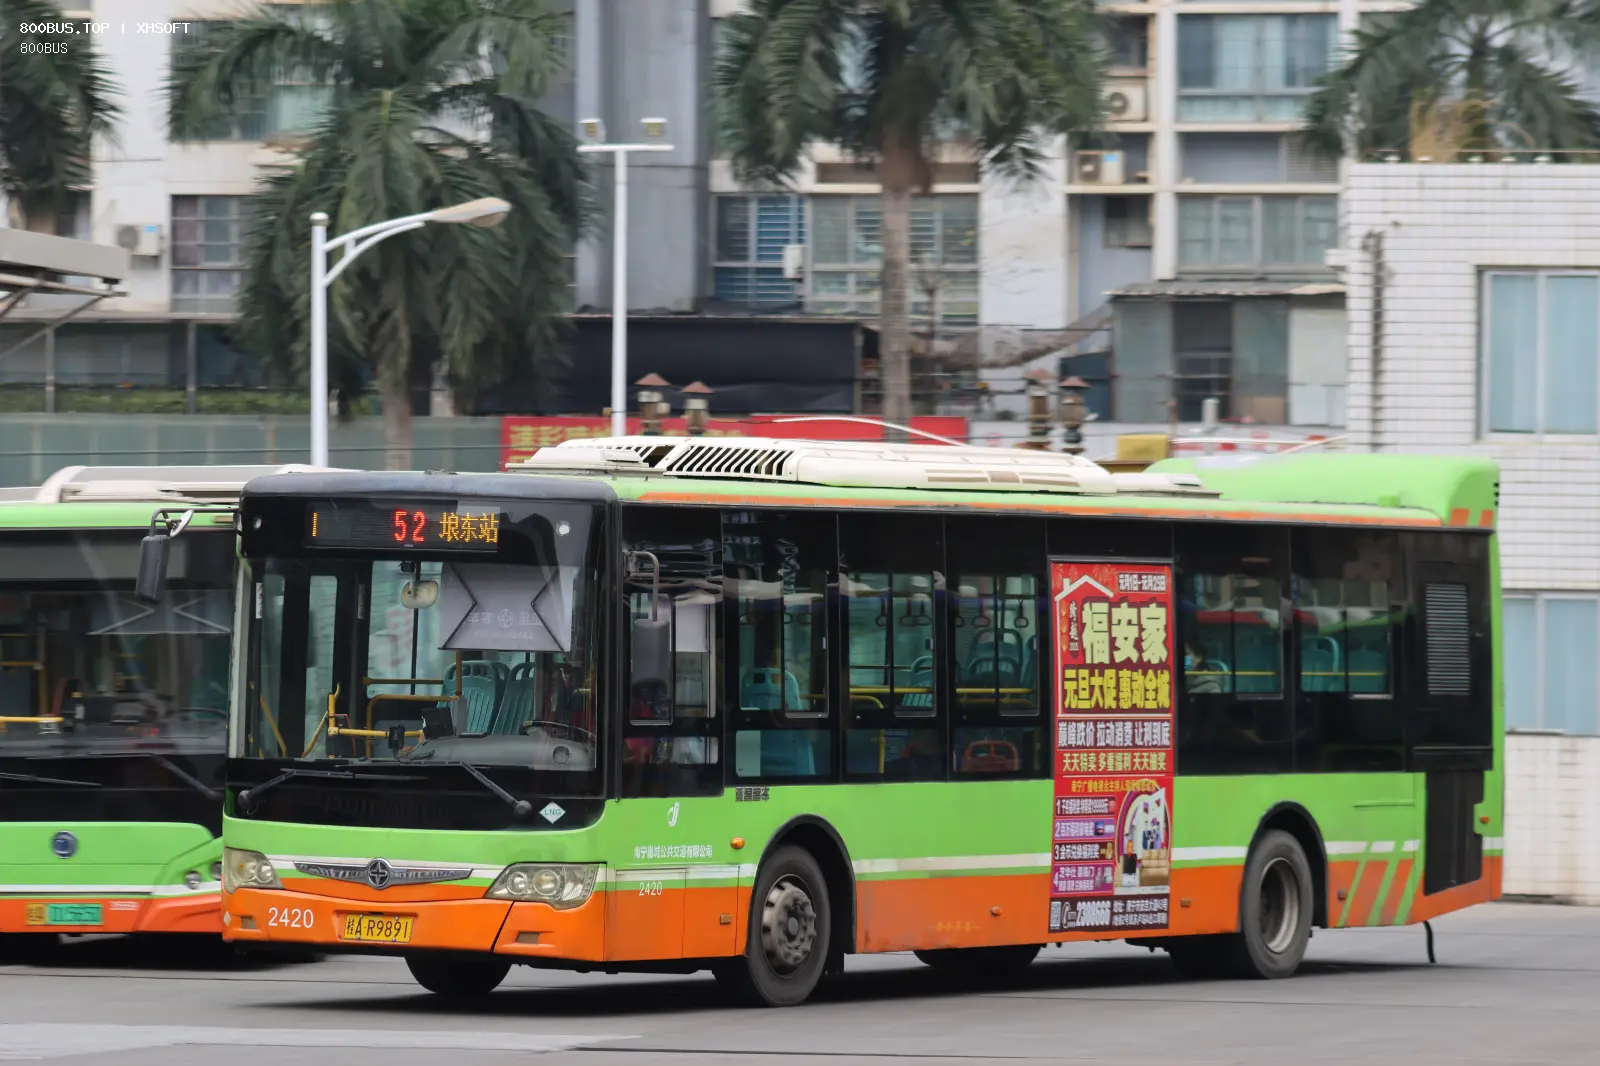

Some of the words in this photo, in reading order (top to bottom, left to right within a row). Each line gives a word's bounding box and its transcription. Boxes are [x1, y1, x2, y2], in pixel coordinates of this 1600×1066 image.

[393, 511, 426, 542] 52
[439, 511, 500, 543] 埌东站
[1082, 601, 1168, 664] 福安家
[1063, 668, 1117, 709] 元旦大促
[1118, 668, 1171, 709] 惠动全城
[1134, 721, 1170, 747] 让利到底
[1063, 752, 1097, 772] 天天特卖
[1098, 752, 1132, 772] 多重福利
[1133, 752, 1167, 771] 天天抽奖
[544, 808, 562, 816] LNG
[638, 881, 663, 897] 2420
[268, 906, 314, 929] 2420
